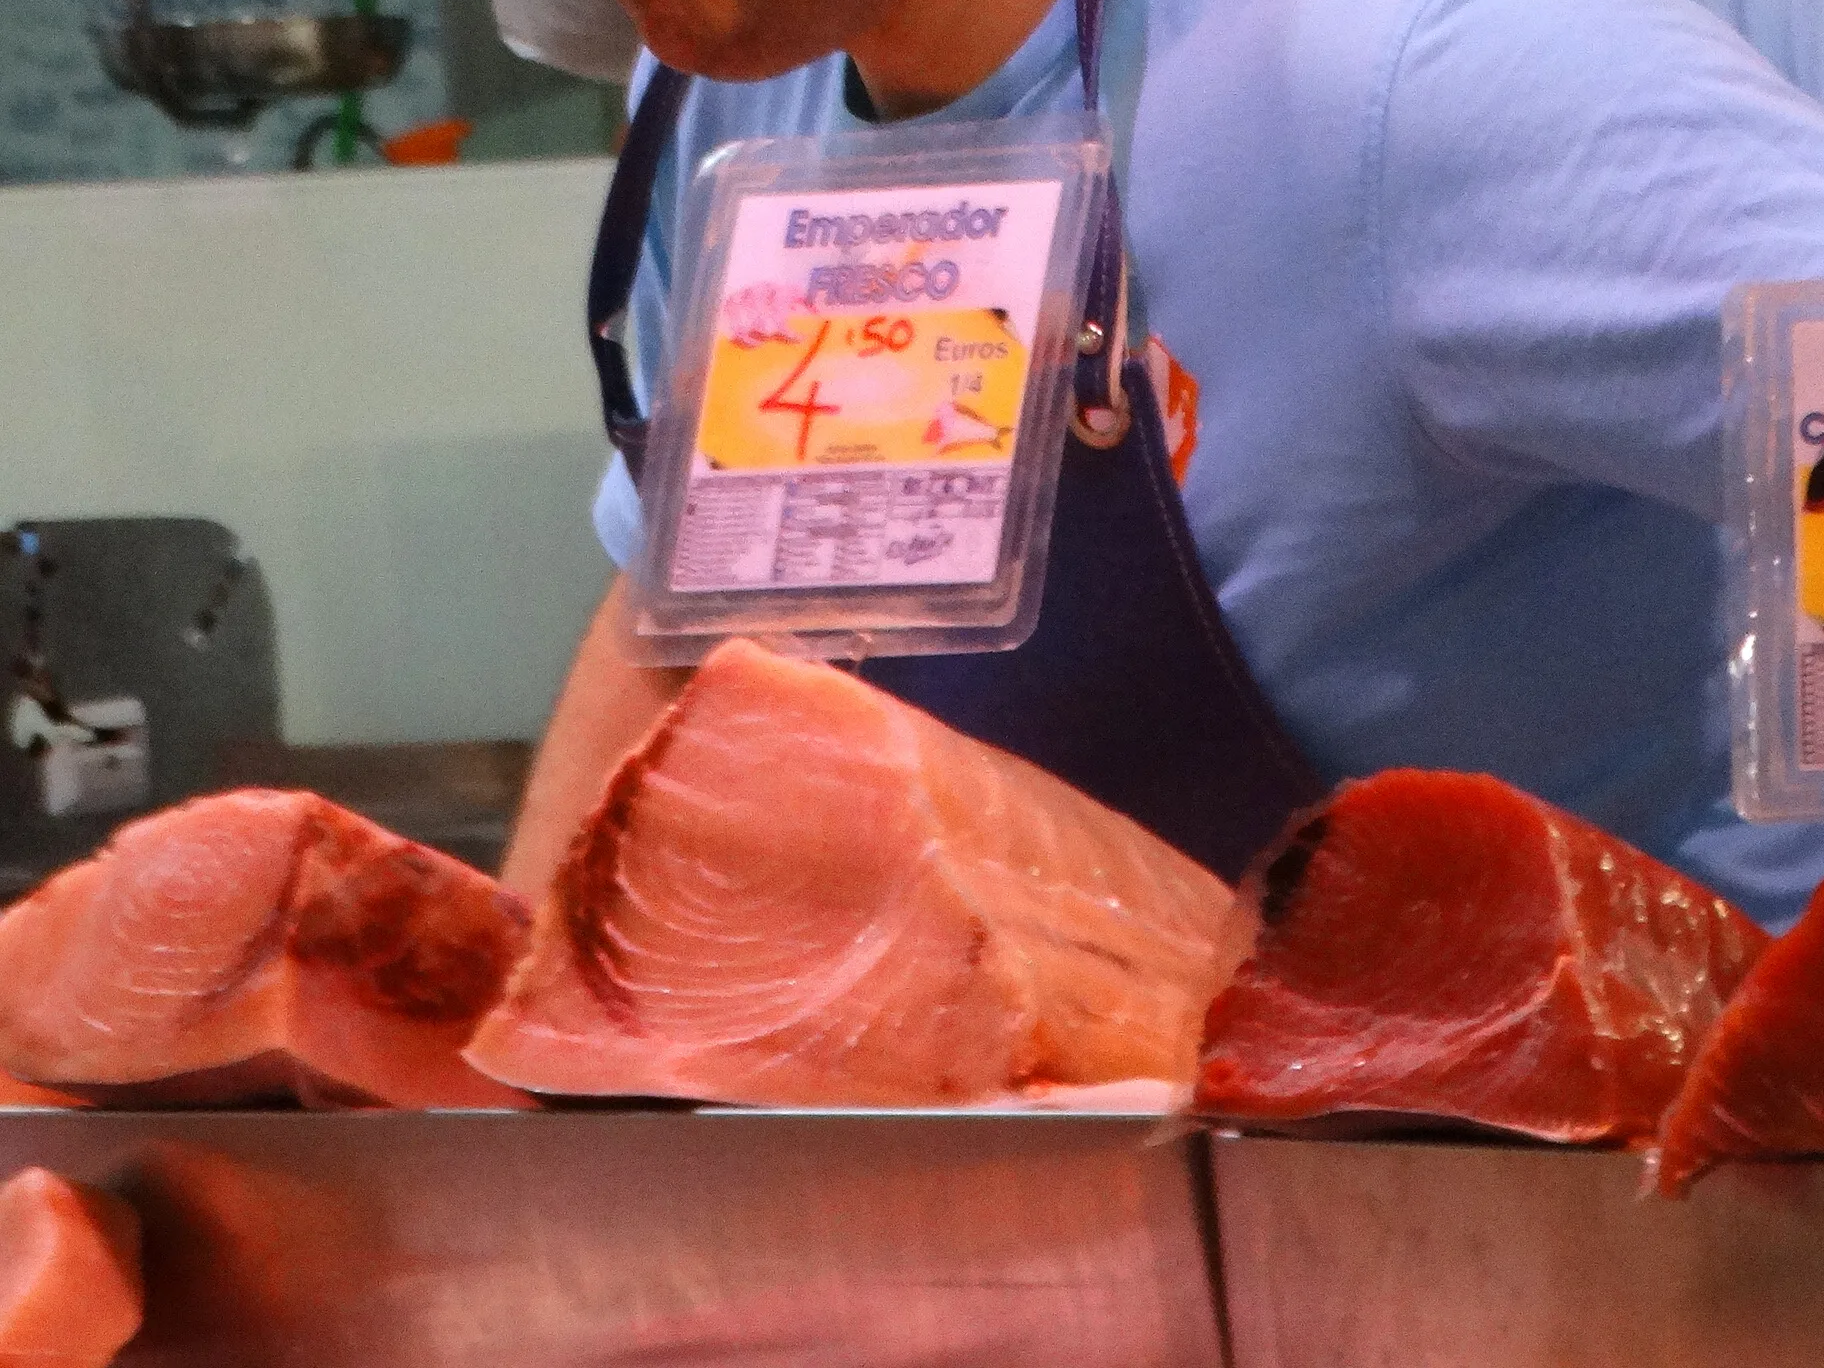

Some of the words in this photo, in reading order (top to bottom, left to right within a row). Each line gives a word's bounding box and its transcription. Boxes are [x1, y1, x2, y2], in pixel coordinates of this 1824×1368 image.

[784, 200, 1009, 249] Emperador
[805, 258, 961, 306] FRESCO
[933, 335, 1009, 362] Euros
